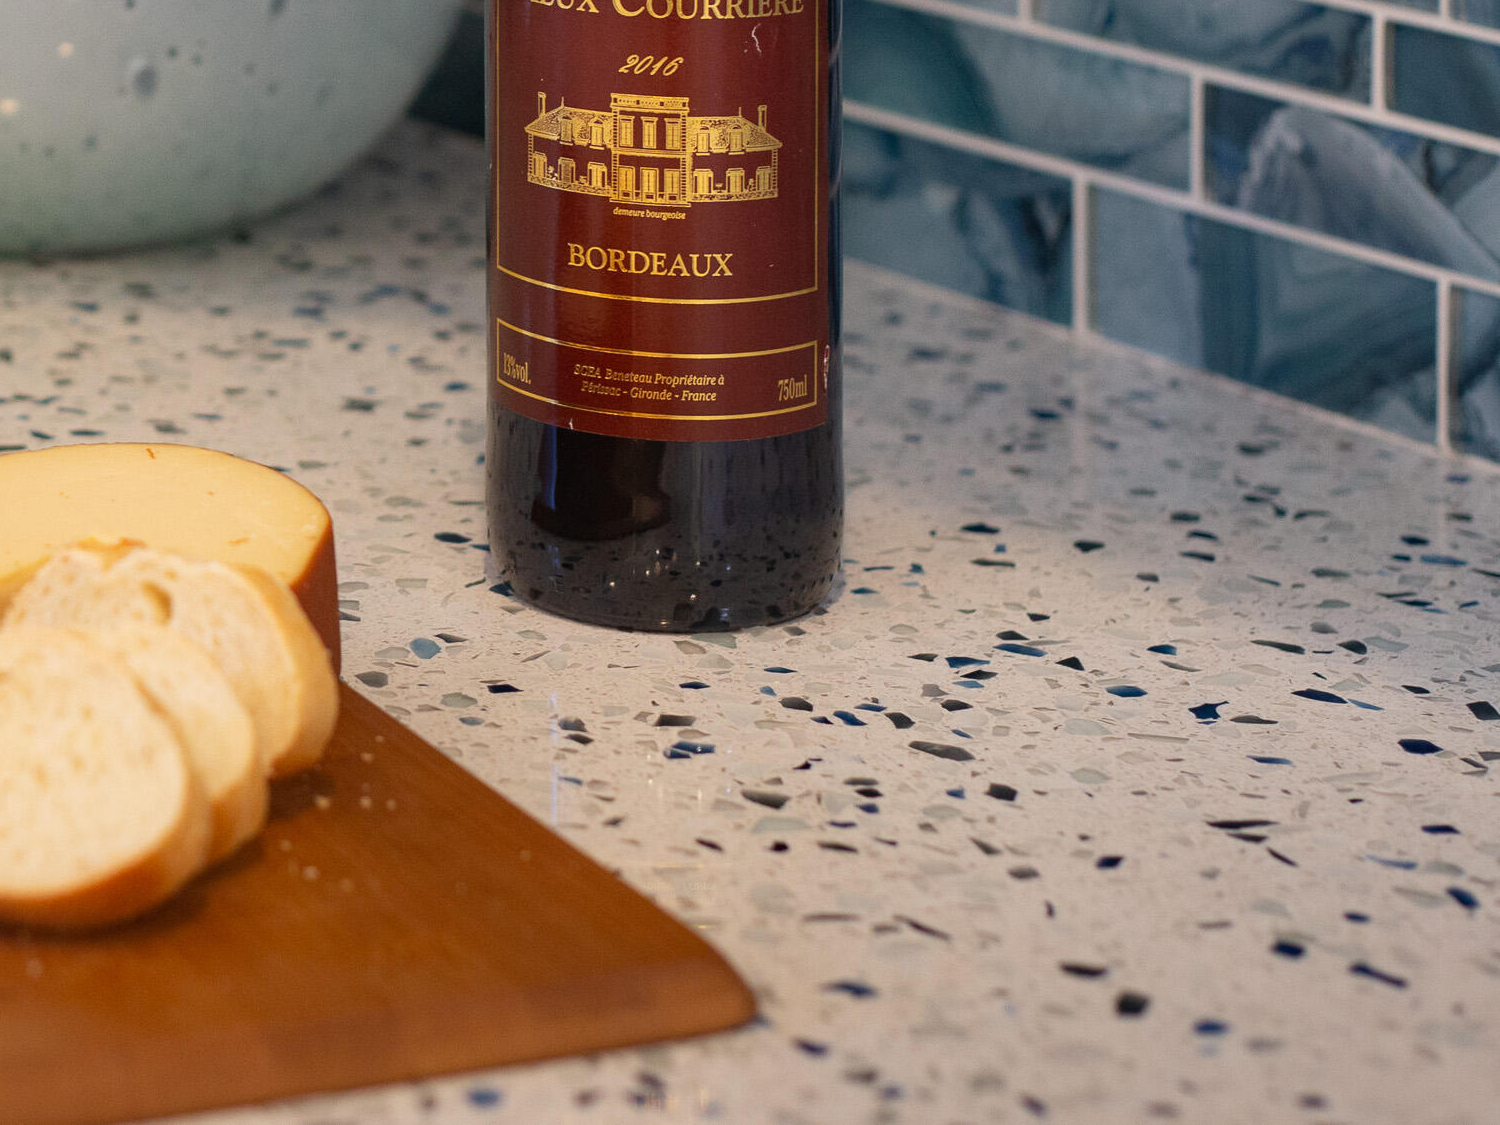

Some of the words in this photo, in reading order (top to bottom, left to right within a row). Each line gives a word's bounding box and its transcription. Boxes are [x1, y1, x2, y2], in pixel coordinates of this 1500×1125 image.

[618, 55, 684, 76] 2016
[612, 206, 646, 218] demeure
[646, 209, 687, 221] bourgeoise
[567, 243, 733, 277] BORDEAUX
[573, 364, 601, 379] SCEA
[654, 373, 716, 388] Propriétaire
[718, 374, 725, 386] à
[630, 386, 672, 400] Gironde
[681, 390, 717, 402] France
[777, 374, 808, 402] 750ml
